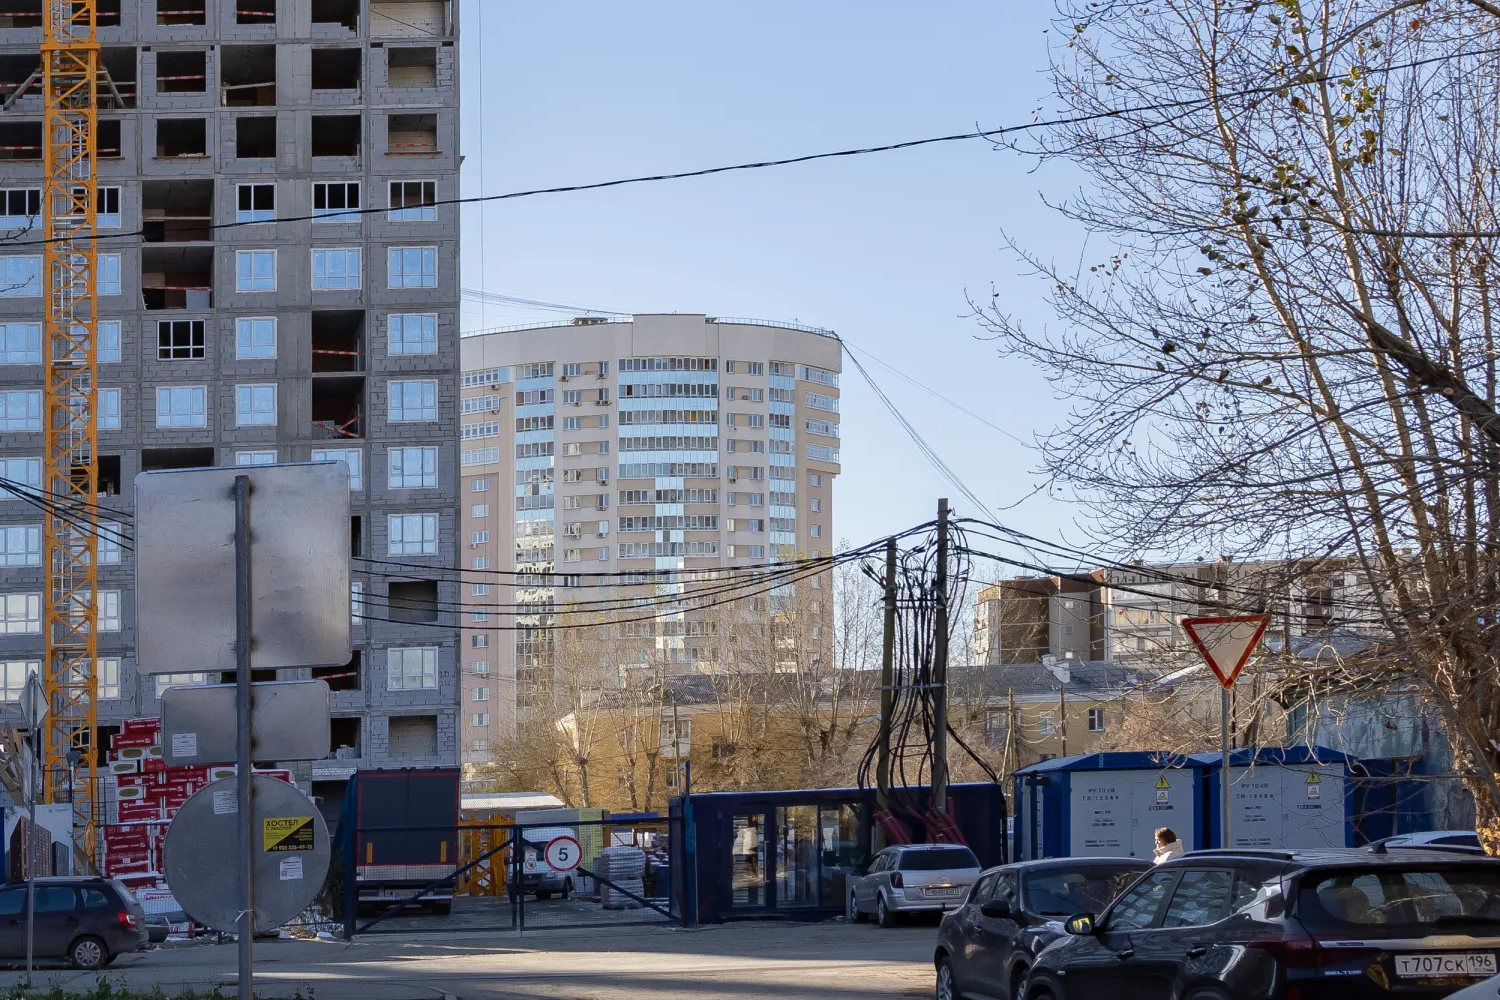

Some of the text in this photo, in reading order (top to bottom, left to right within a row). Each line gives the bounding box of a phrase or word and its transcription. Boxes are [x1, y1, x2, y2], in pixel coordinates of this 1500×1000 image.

[558, 848, 569, 862] 5
[1401, 955, 1492, 973] Т707СК 196
